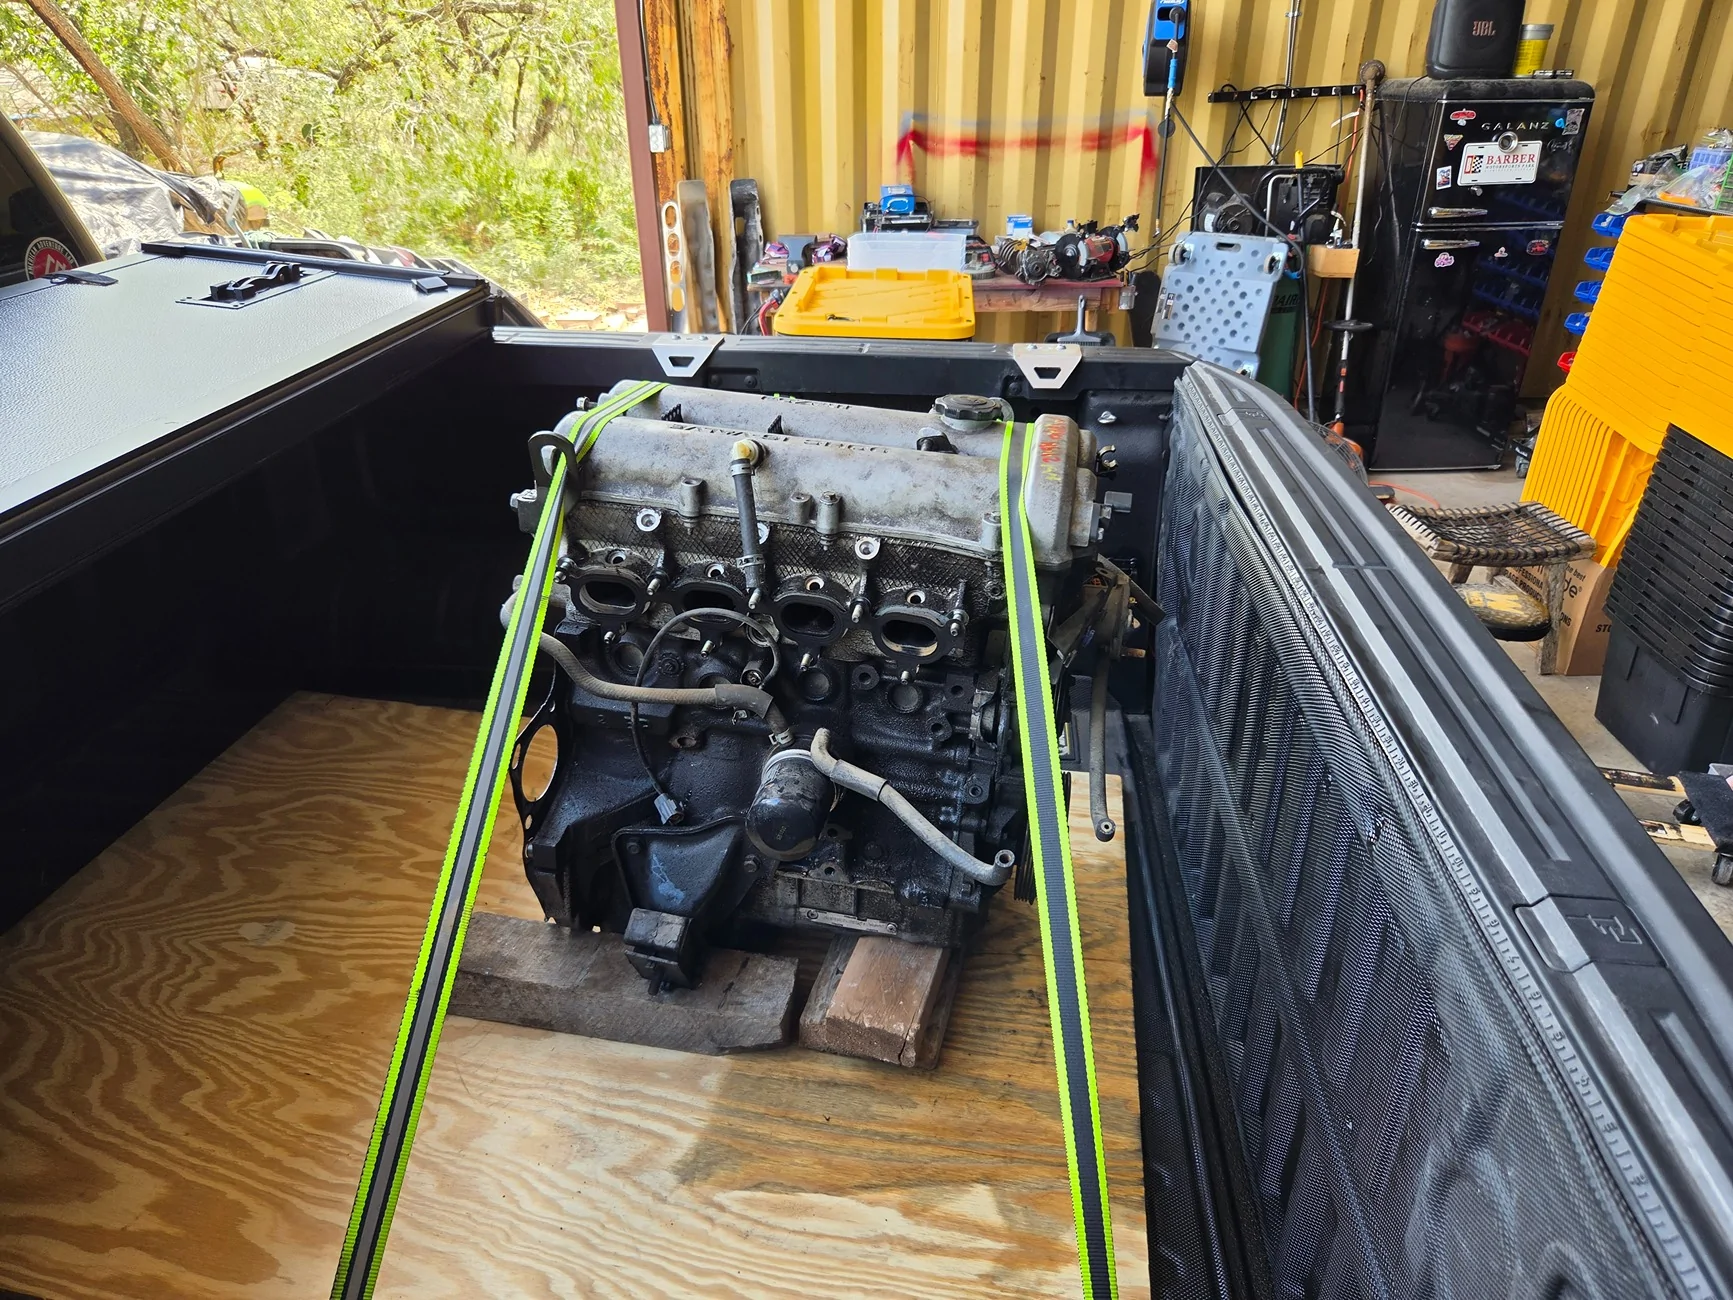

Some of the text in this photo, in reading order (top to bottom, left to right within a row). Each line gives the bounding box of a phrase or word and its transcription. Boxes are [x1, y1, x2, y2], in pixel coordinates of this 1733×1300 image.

[1472, 21, 1496, 36] JBL
[1481, 122, 1549, 131] GALANZ
[1486, 154, 1536, 165] BARBER
[37, 240, 64, 253] ADVENTURE
[1572, 568, 1586, 582] best
[1518, 579, 1543, 602] PRODUCT
[1559, 612, 1572, 627] ONS
